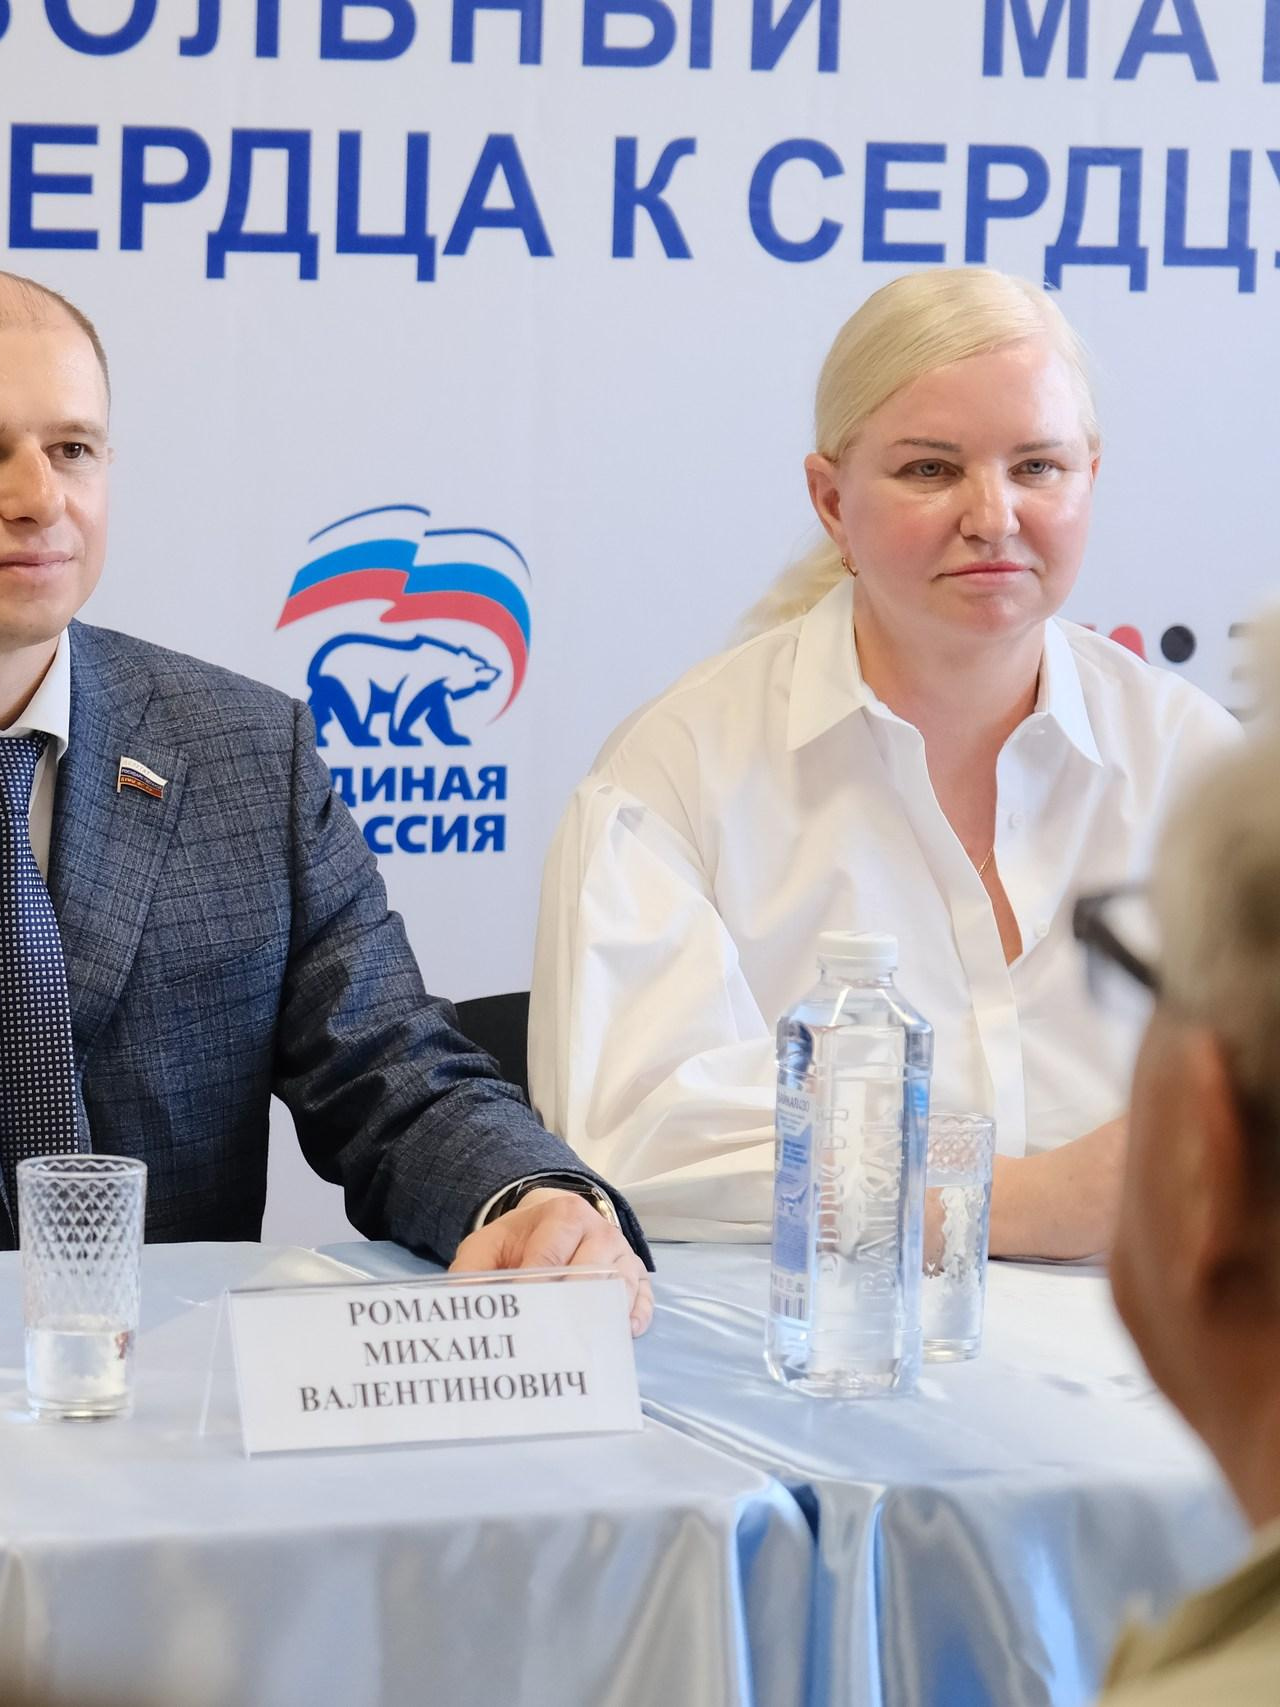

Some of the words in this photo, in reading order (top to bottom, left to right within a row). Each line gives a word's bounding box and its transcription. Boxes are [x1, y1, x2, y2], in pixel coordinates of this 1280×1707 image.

[611, 136, 698, 262] К
[748, 138, 1280, 295] СЕРДЦ
[329, 763, 510, 808] ДИНАЯ
[361, 813, 509, 856] ССИЯ
[348, 1294, 520, 1327] РОМАНОВ
[363, 1334, 517, 1366] МИХАИЛ
[299, 1370, 589, 1412] ВАЛЕНТИНОВИЧ
